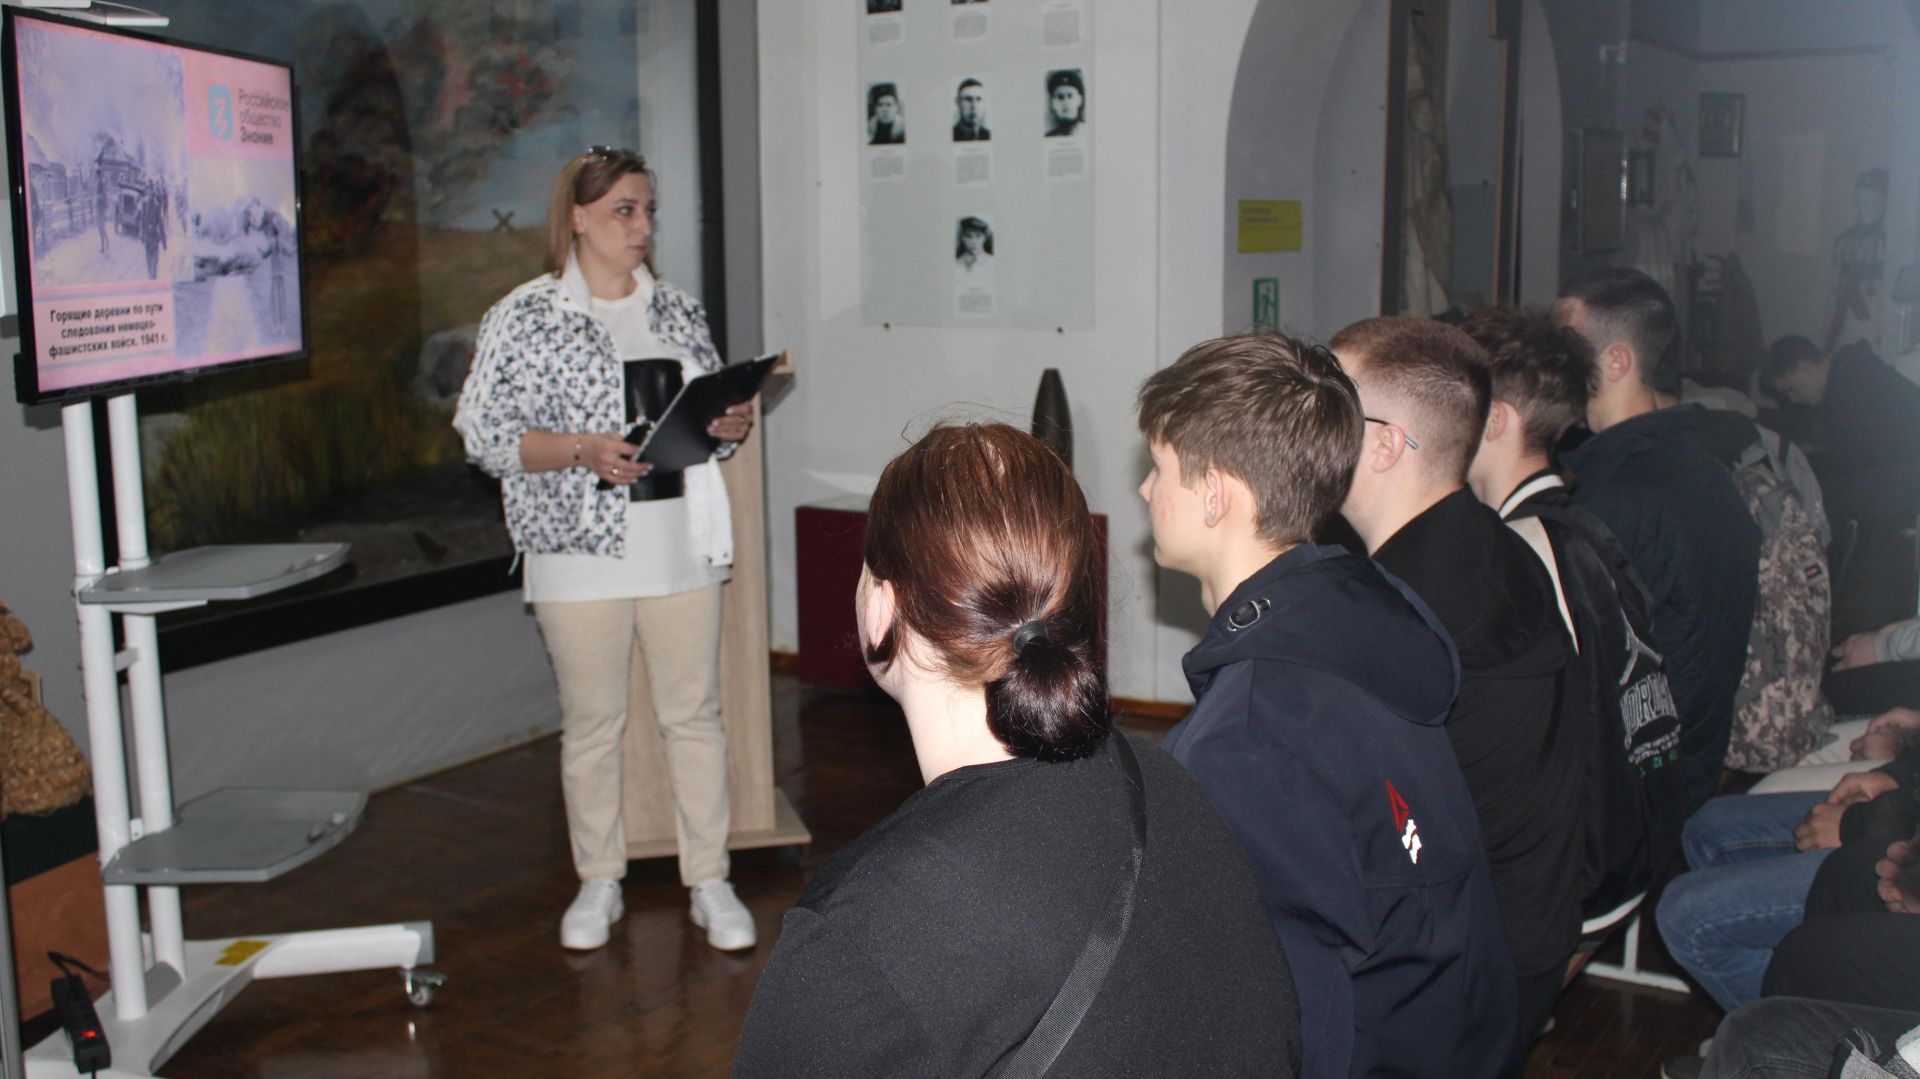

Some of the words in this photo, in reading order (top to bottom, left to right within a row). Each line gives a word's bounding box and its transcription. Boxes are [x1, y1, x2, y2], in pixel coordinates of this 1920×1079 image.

[239, 88, 289, 112] Российское
[240, 108, 282, 128] общество
[240, 126, 274, 145] Знание
[50, 309, 92, 325] Горящие
[94, 306, 131, 319] деревни
[133, 304, 143, 314] по
[145, 304, 163, 316] пути
[61, 324, 116, 339] следования
[118, 320, 156, 332] немецко-
[49, 341, 108, 360] фашистских
[111, 337, 138, 349] войск.
[140, 332, 159, 345] 1941
[161, 334, 168, 343] г.
